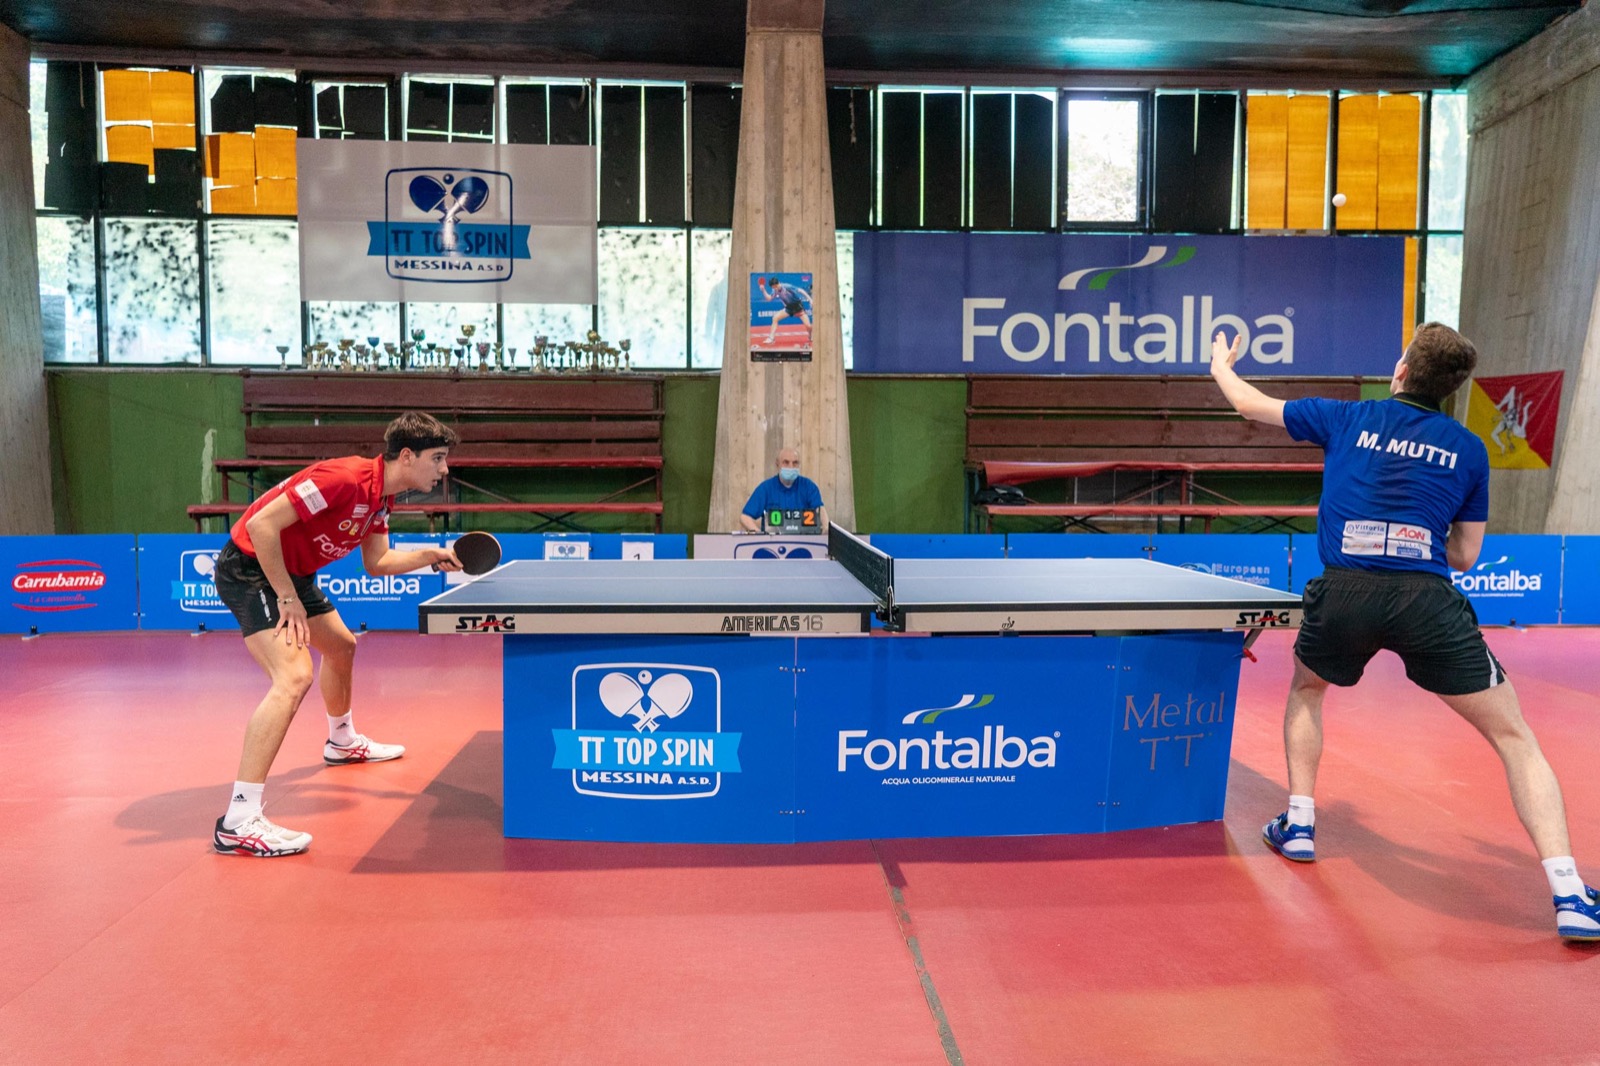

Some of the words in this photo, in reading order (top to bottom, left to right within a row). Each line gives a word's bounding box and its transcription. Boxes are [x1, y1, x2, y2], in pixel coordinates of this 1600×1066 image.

[391, 229, 414, 253] TT
[464, 231, 507, 255] SPIN
[394, 260, 473, 271] MESSINA
[962, 295, 1294, 364] Fontalba
[1356, 430, 1381, 451] M.
[1386, 438, 1458, 469] MUTTI
[771, 511, 782, 525] 0
[803, 511, 815, 525] 2
[1215, 563, 1270, 575] European
[13, 572, 104, 588] Carrubamia
[317, 574, 420, 595] Fontalba
[1450, 569, 1542, 591] Fontalba
[183, 584, 196, 597] TT
[455, 615, 516, 632] STAG
[721, 616, 800, 631] AMERICAS
[803, 615, 823, 631] 16
[1235, 610, 1291, 627] STAG
[1122, 691, 1225, 730] Metal
[578, 736, 605, 764] TT
[613, 737, 658, 765] TOP
[662, 738, 714, 766] SPIN
[837, 725, 1057, 772] Fontalba
[1139, 733, 1205, 771] TT
[582, 771, 673, 785] MESSINA
[881, 778, 910, 786] ACQUA
[912, 776, 974, 784] OLIGOMINERALE
[976, 775, 1016, 783] NATURALE
